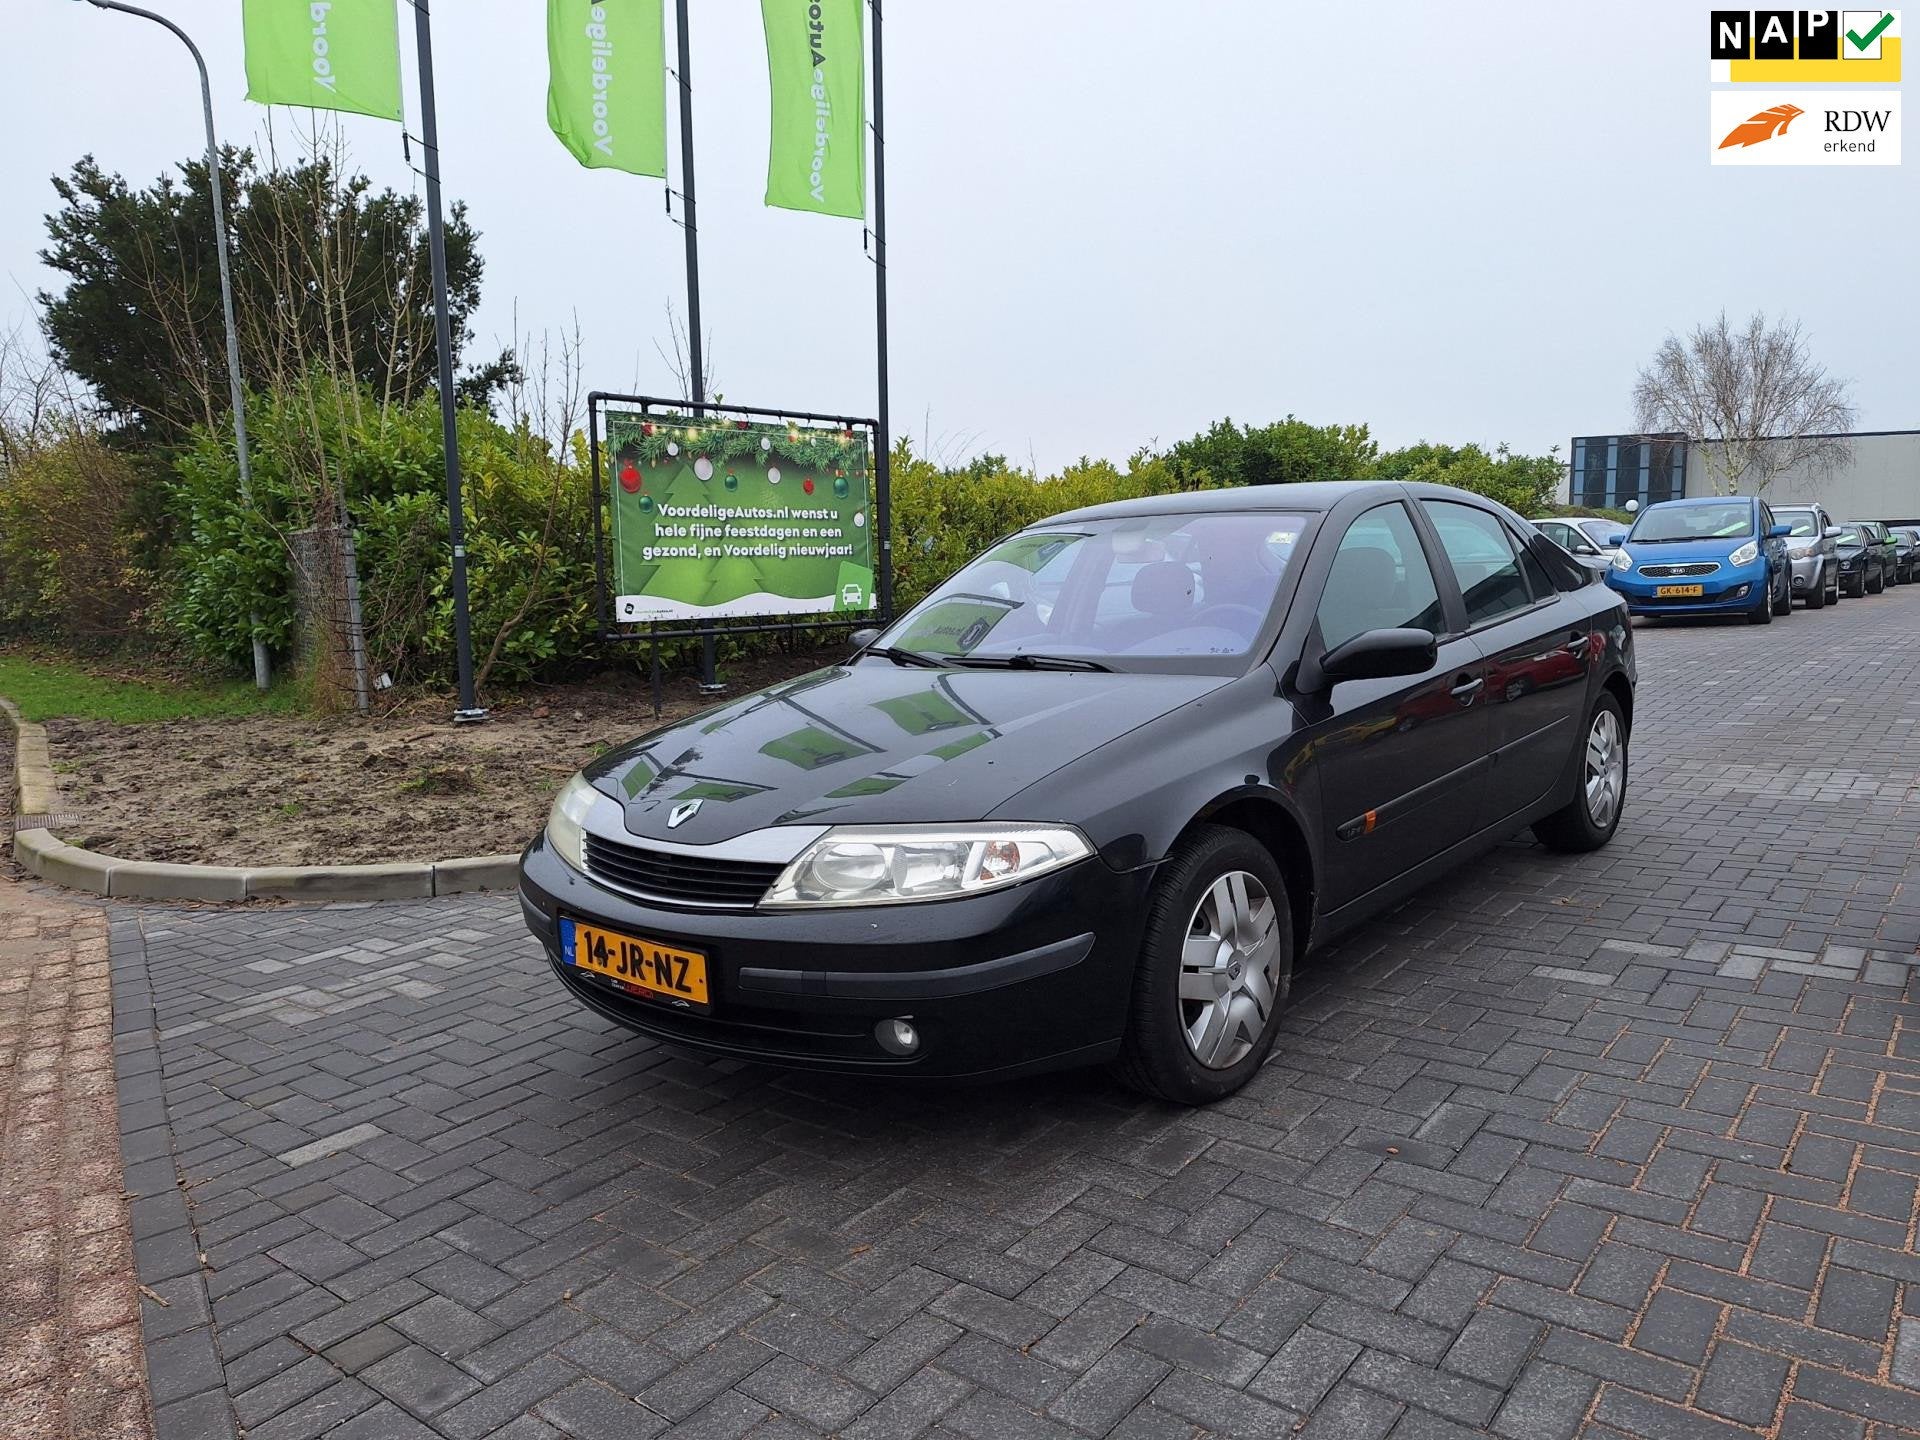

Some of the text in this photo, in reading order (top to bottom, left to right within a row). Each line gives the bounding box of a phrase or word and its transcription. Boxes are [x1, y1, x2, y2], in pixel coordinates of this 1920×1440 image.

[658, 503, 838, 521] VoordeligeAutos.nl wenst u
[655, 522, 842, 540] hele fijne feestdagen en een
[642, 542, 853, 560] gezond, en Voordelig nieuwjaar!
[564, 945, 575, 957] NL
[583, 930, 692, 993] 14-JR-NZ
